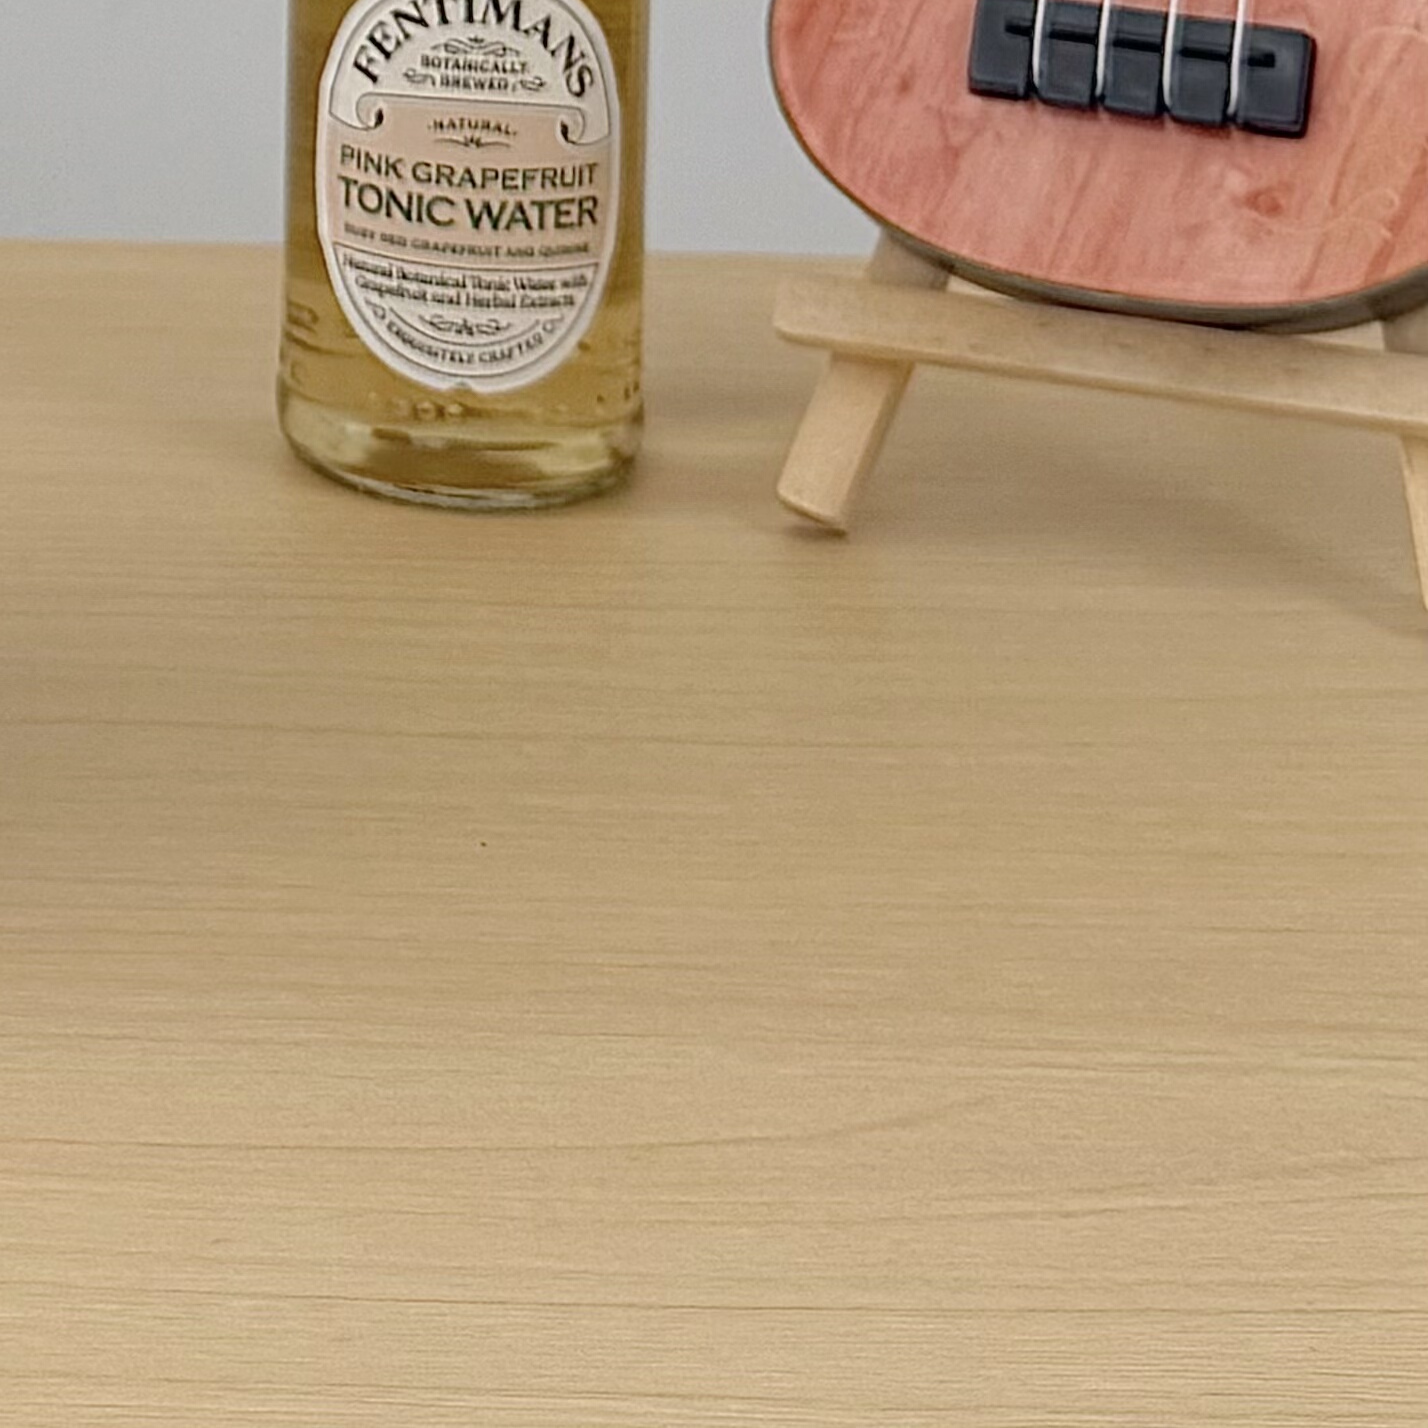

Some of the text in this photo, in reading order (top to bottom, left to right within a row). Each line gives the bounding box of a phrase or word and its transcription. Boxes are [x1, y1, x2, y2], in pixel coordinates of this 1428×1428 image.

[421, 54, 527, 72] BOTANICALLY
[340, 144, 598, 190] PINK GRAPEFRUIT
[337, 174, 599, 231] TONIC WATER
[411, 237, 500, 258] GRAPEFRUIT
[344, 254, 393, 279] Natural
[396, 267, 466, 289] Botanical
[470, 273, 510, 291] Tonic
[513, 276, 556, 292] Water
[354, 275, 575, 309] Grapefruit and Herbal Extracts
